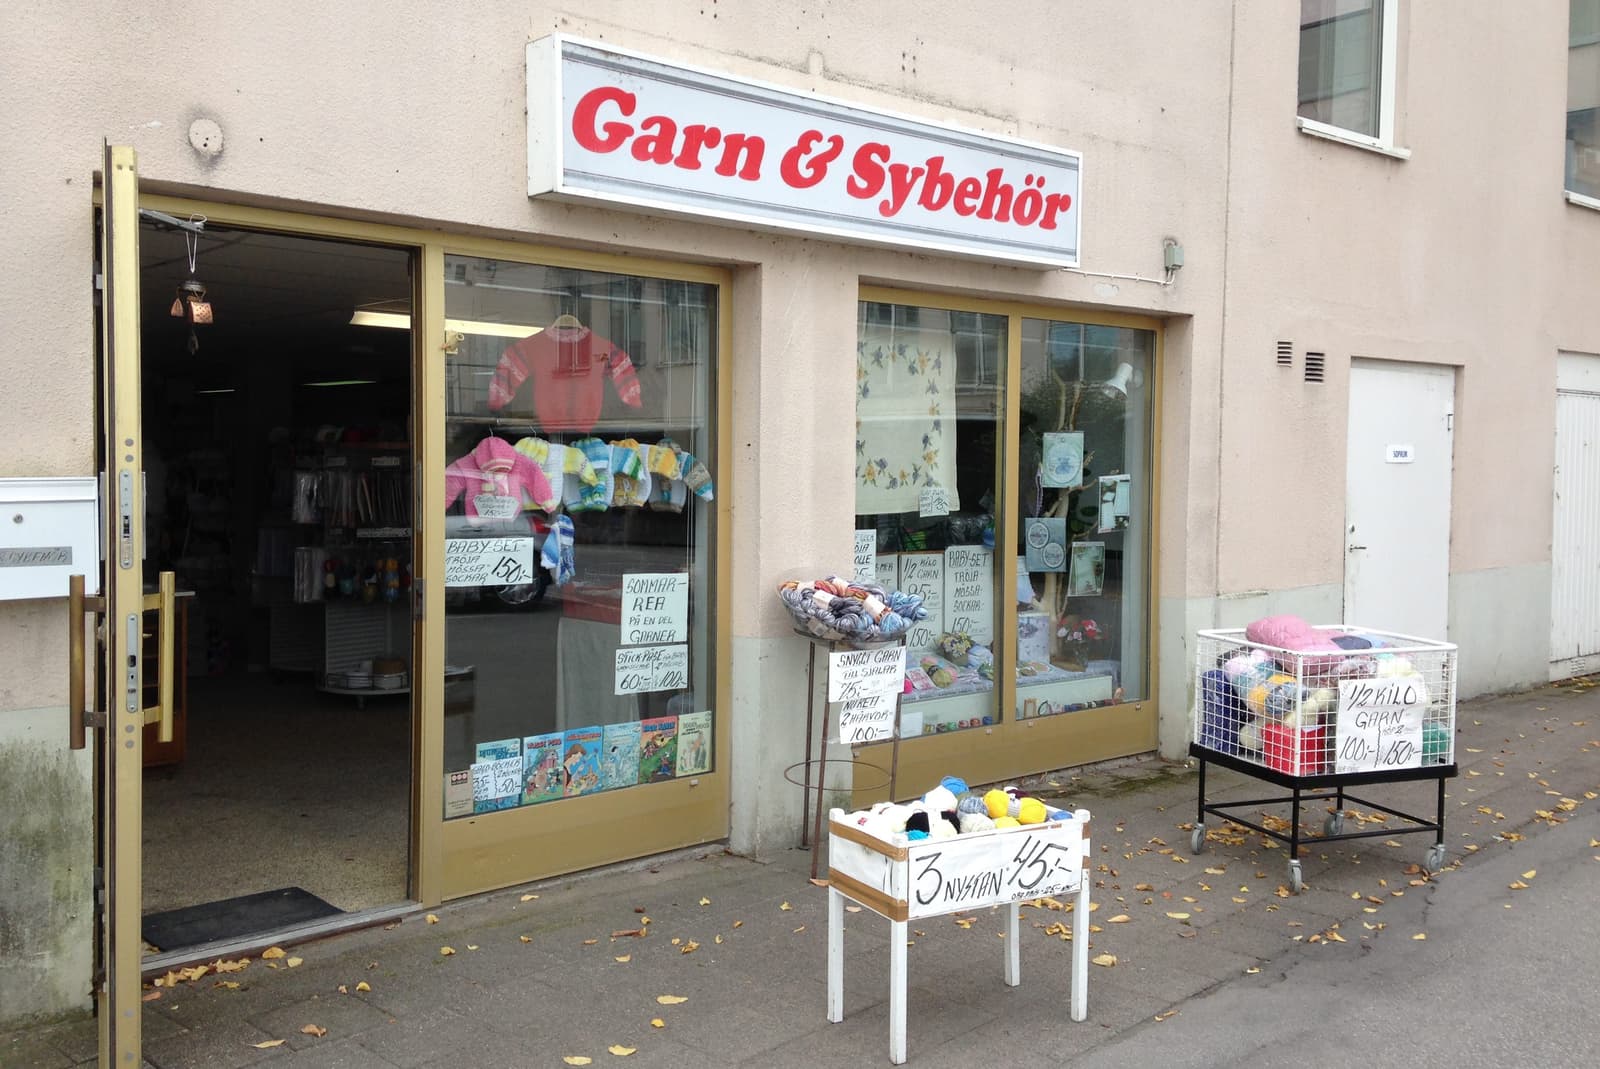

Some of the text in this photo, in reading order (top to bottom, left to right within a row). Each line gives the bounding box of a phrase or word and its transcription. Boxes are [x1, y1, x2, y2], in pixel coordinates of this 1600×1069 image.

[572, 86, 1071, 231] Garn & Sybehör
[491, 556, 532, 583] 150:-
[633, 596, 666, 611] REA
[643, 617, 655, 625] EN
[630, 629, 676, 644] GARNER
[874, 649, 902, 663] GARN
[1347, 683, 1374, 711] 1/2
[1355, 708, 1405, 730] GARN
[850, 726, 888, 742] 100:-
[1339, 736, 1375, 761] 100:-
[1383, 740, 1422, 766] 150:-
[915, 852, 943, 905] 3
[1007, 835, 1072, 889] 45:-
